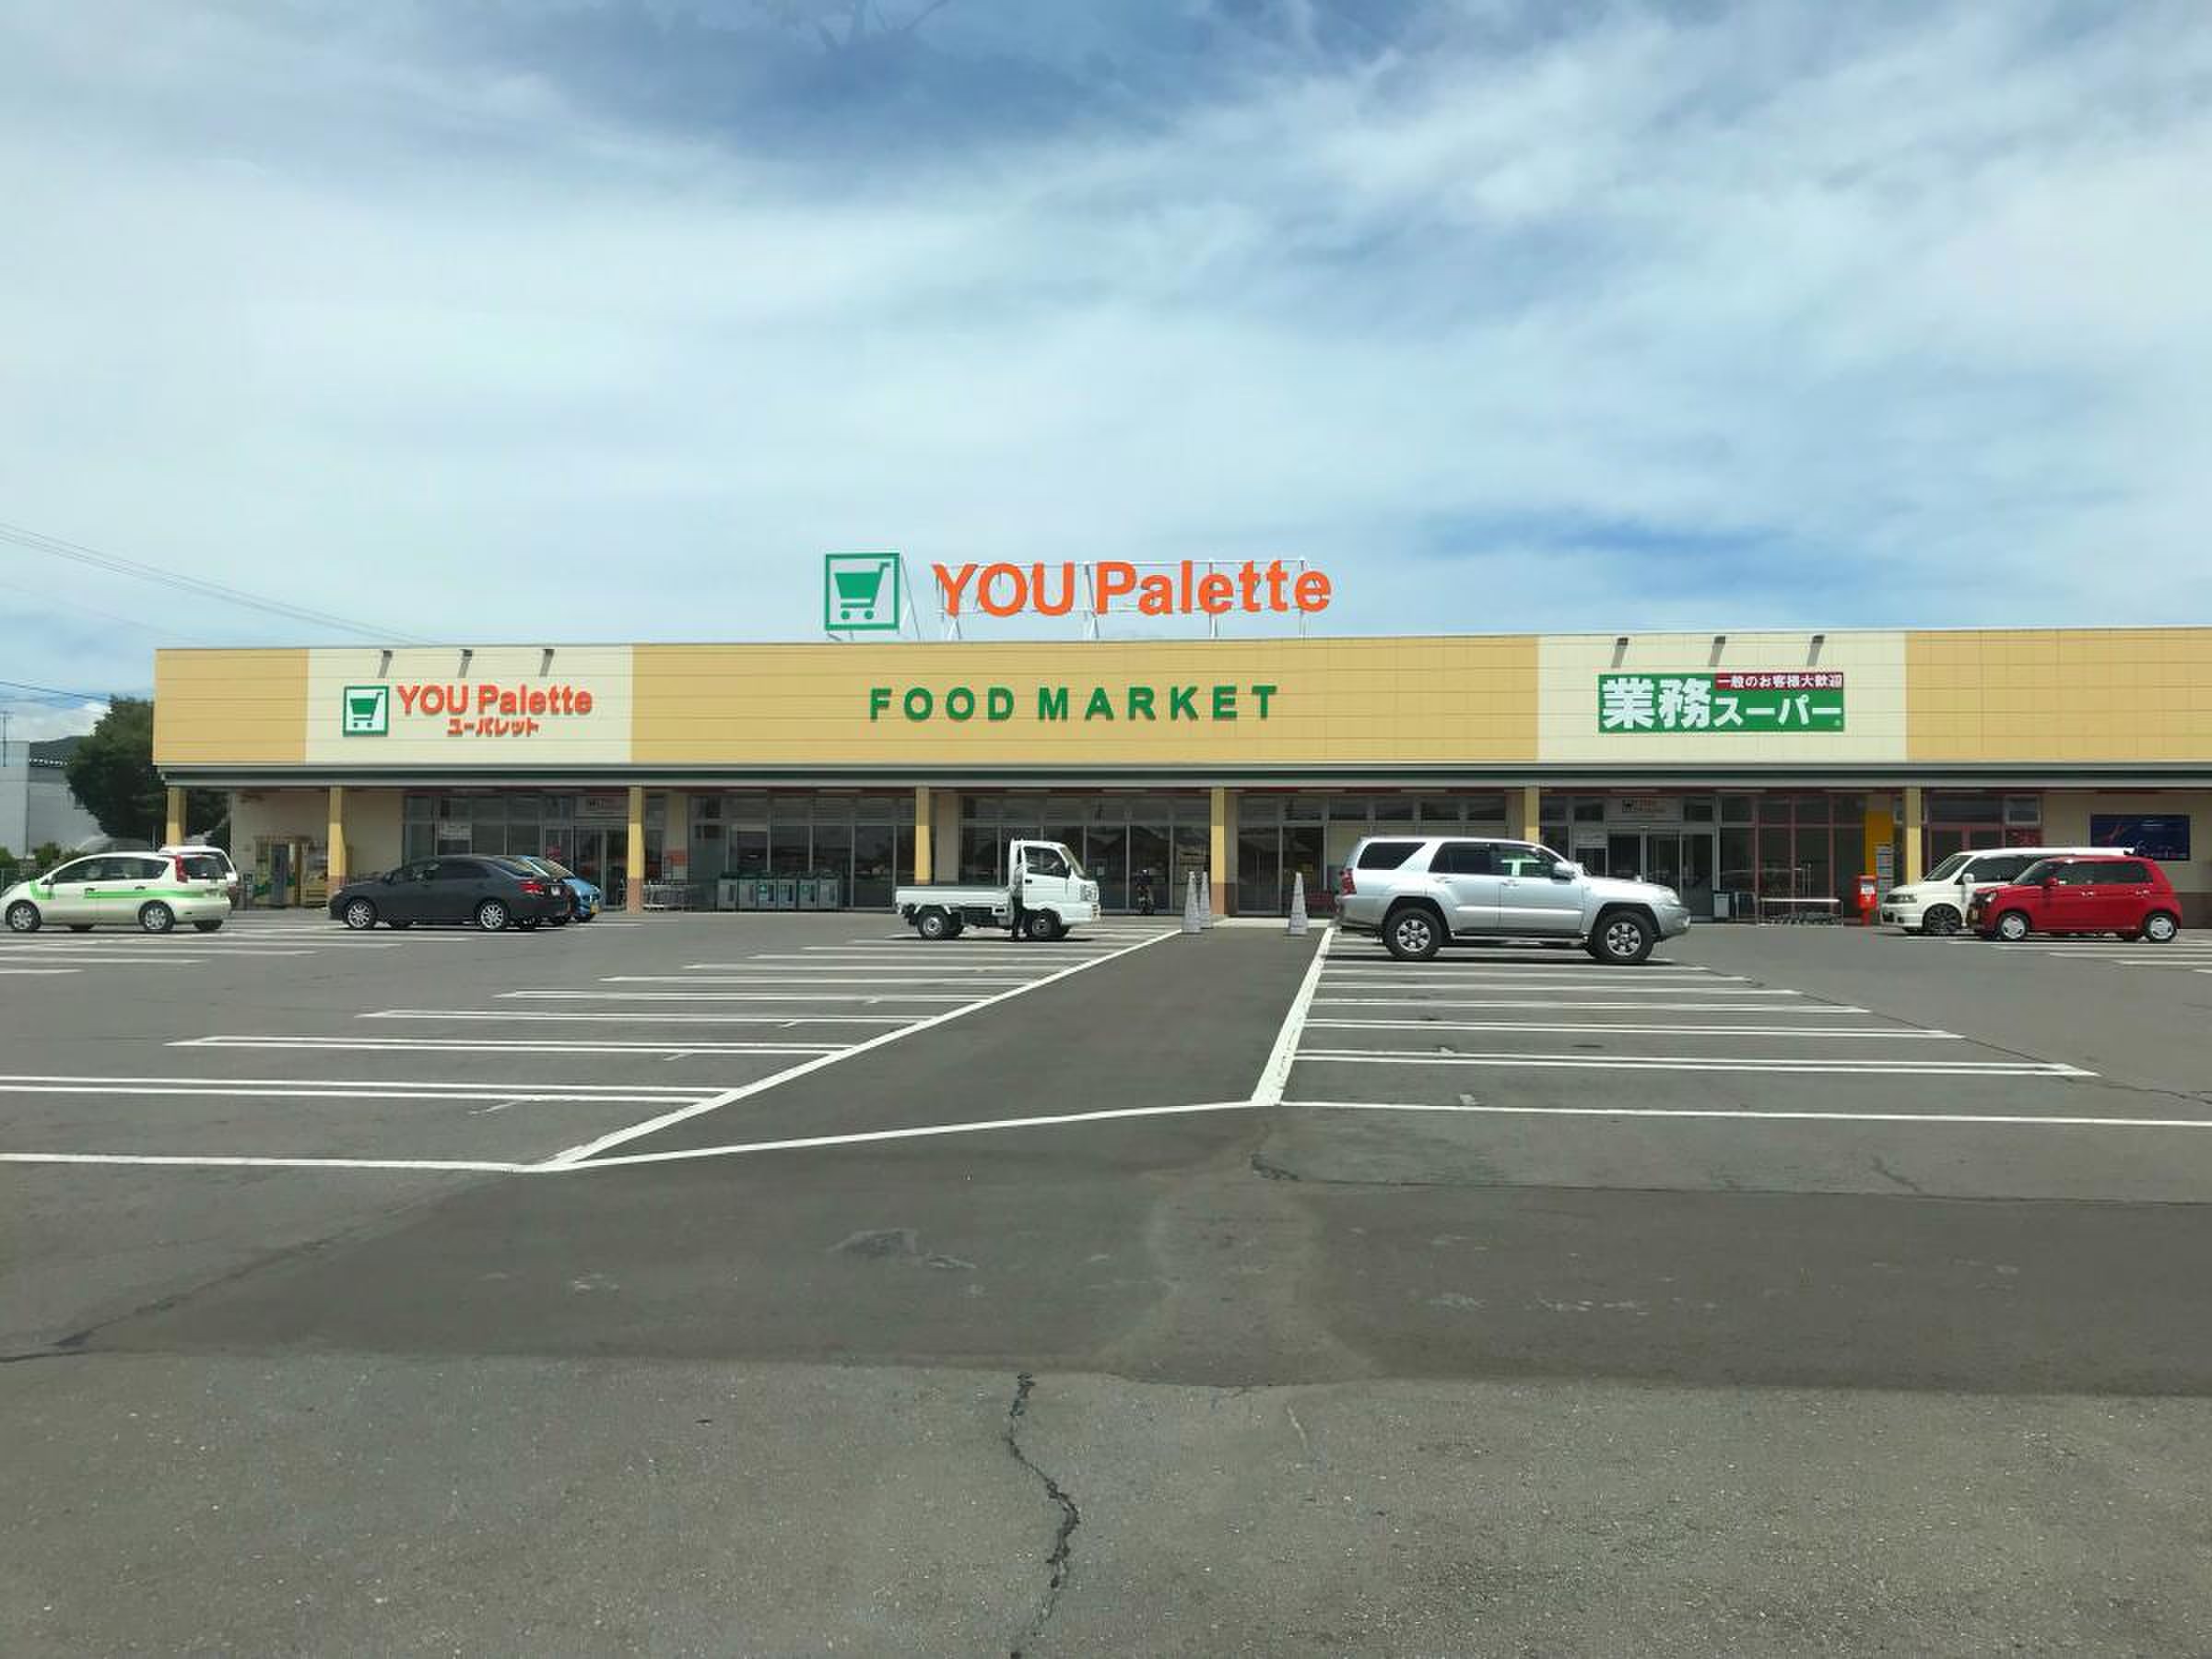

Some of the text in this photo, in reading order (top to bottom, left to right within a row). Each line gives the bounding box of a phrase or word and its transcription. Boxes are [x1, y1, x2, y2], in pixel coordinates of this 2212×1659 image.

[932, 559, 1332, 617] YOU Palette
[396, 683, 593, 716] YOU Palette
[869, 684, 1277, 722] FOOD MARKET
[1602, 677, 1841, 729] 業務スーパー
